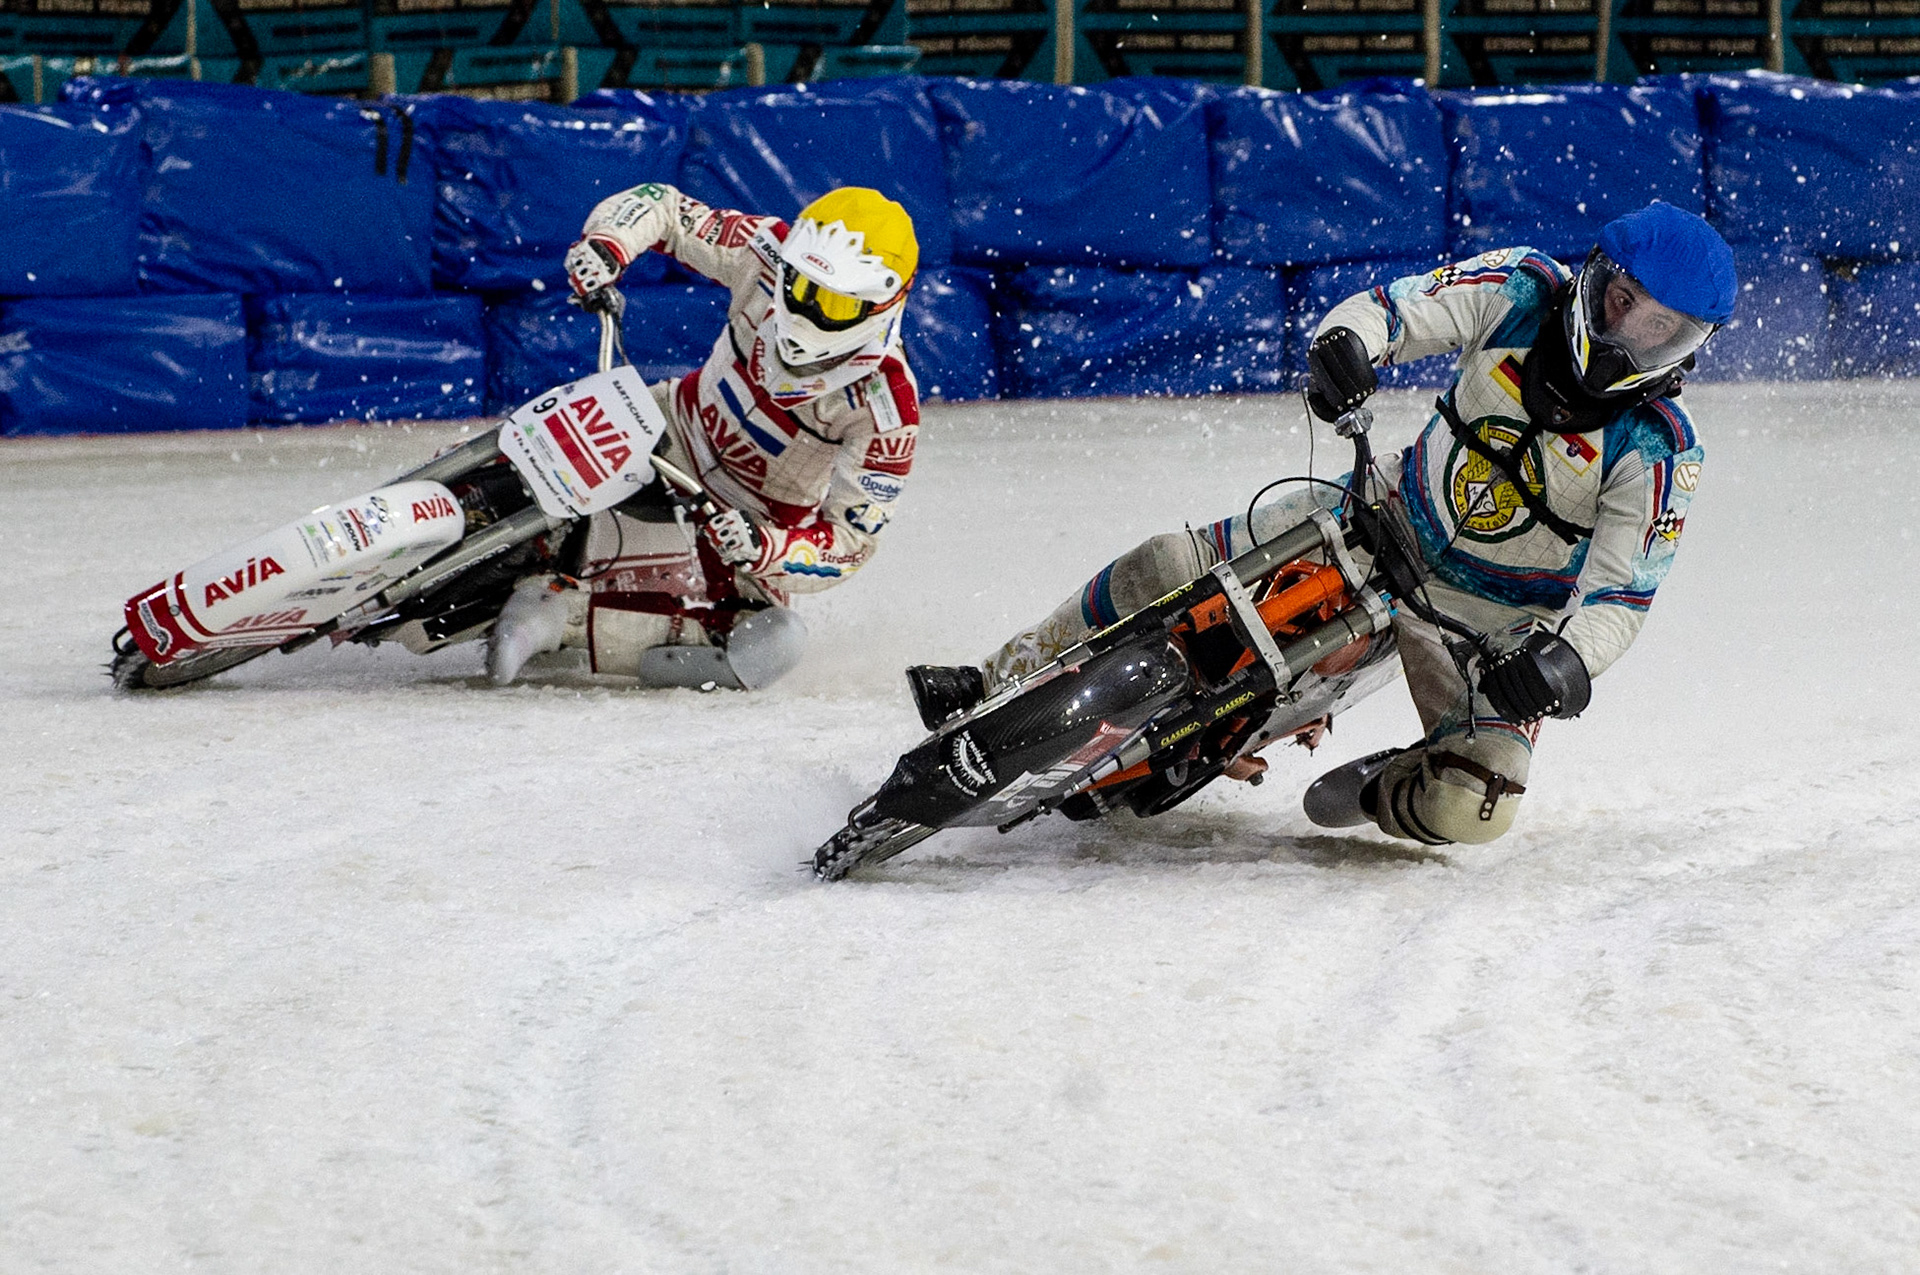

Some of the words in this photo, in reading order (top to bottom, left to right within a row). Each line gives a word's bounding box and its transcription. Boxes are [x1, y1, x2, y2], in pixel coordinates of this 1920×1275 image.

[806, 254, 831, 272] BELL
[612, 379, 630, 404] BART
[204, 556, 285, 608] AVIA
[1215, 691, 1255, 716] CLASSICA
[1160, 721, 1201, 747] CLASSICA
